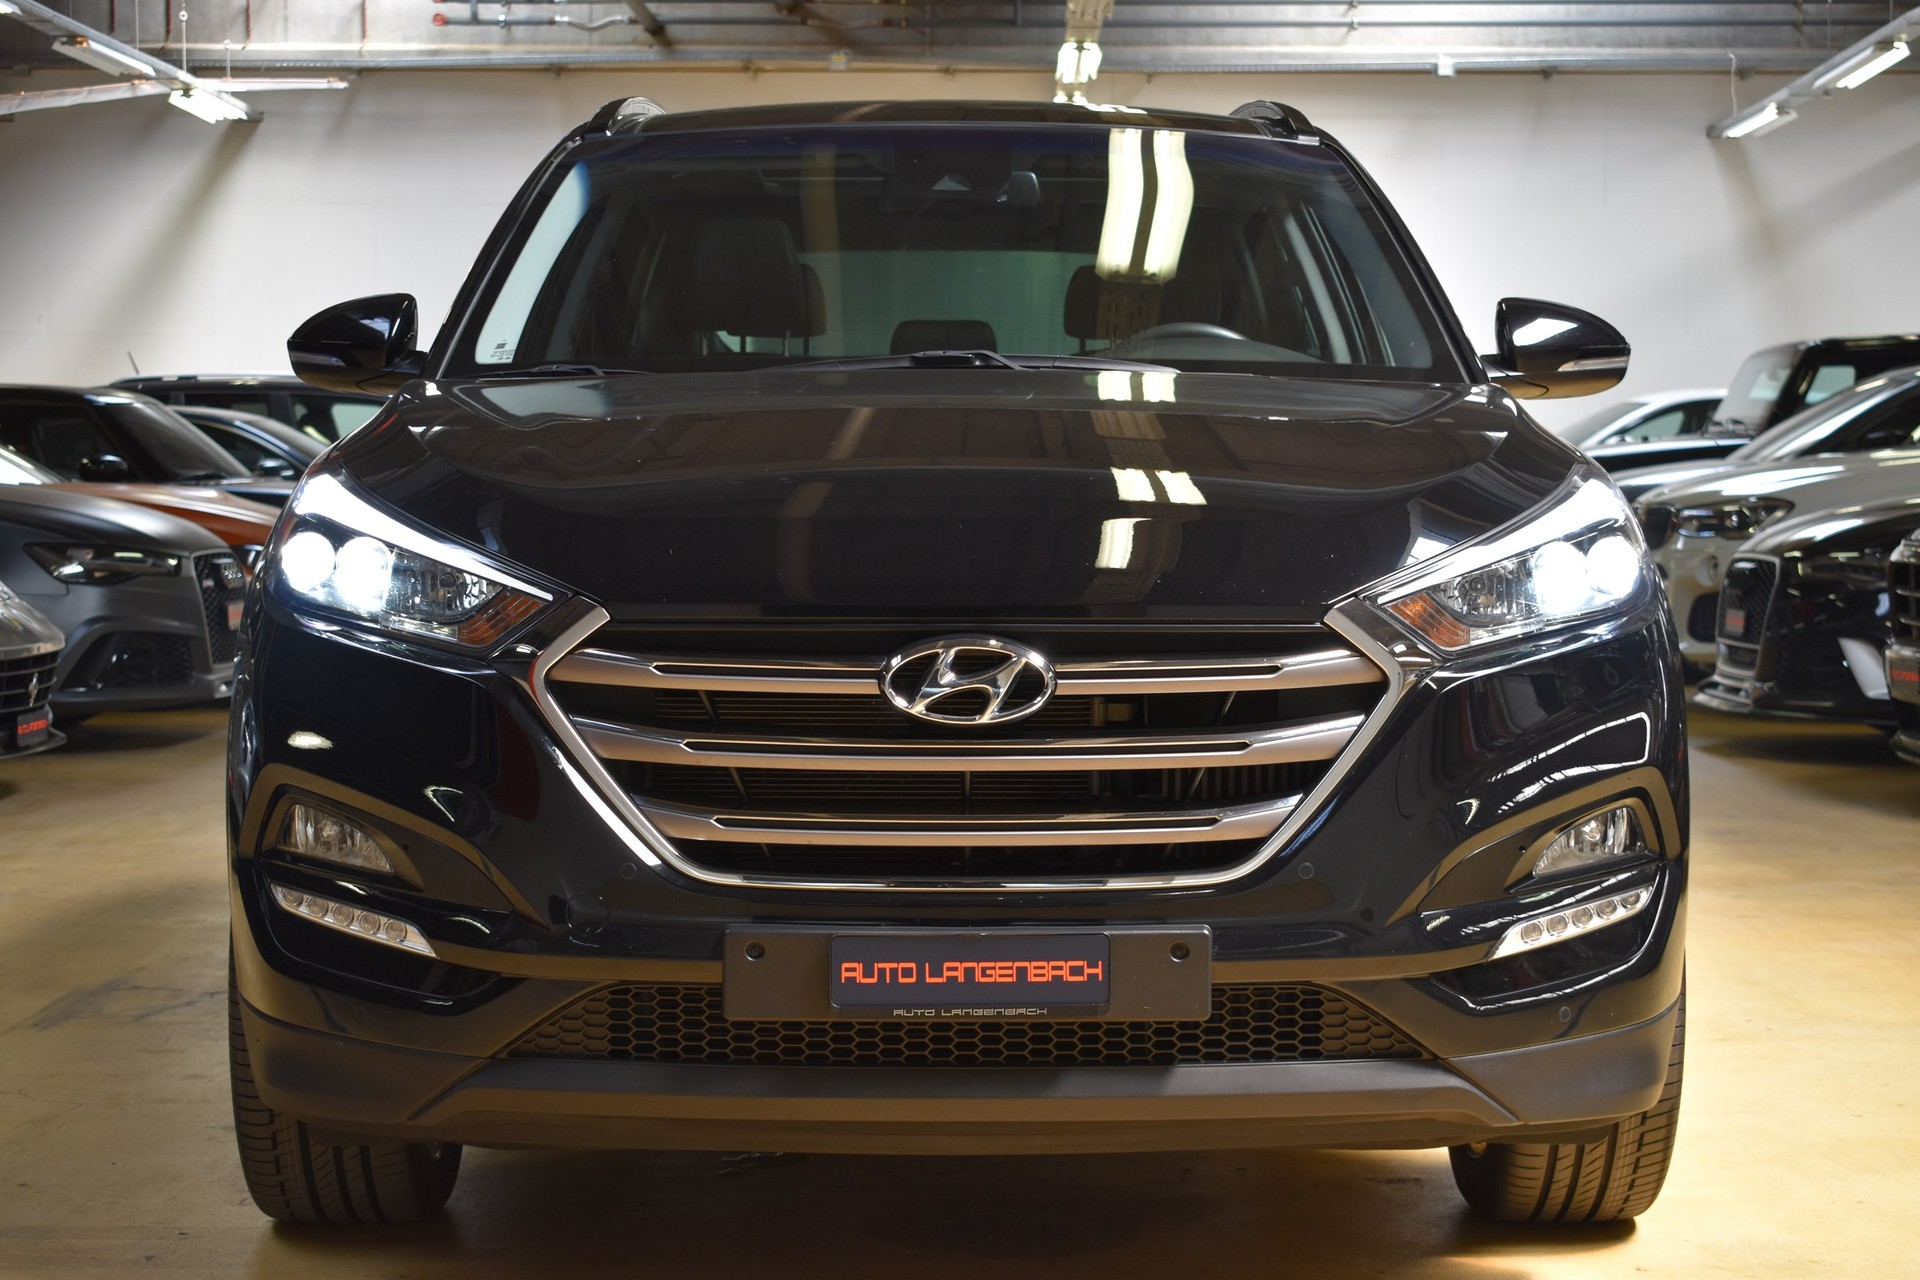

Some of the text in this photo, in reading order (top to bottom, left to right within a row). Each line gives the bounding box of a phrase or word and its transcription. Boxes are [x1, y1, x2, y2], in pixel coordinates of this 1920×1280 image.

[840, 960, 1104, 984] AUTO LANGENBACH
[893, 1007, 1048, 1016] AUTO LANGENBACH
